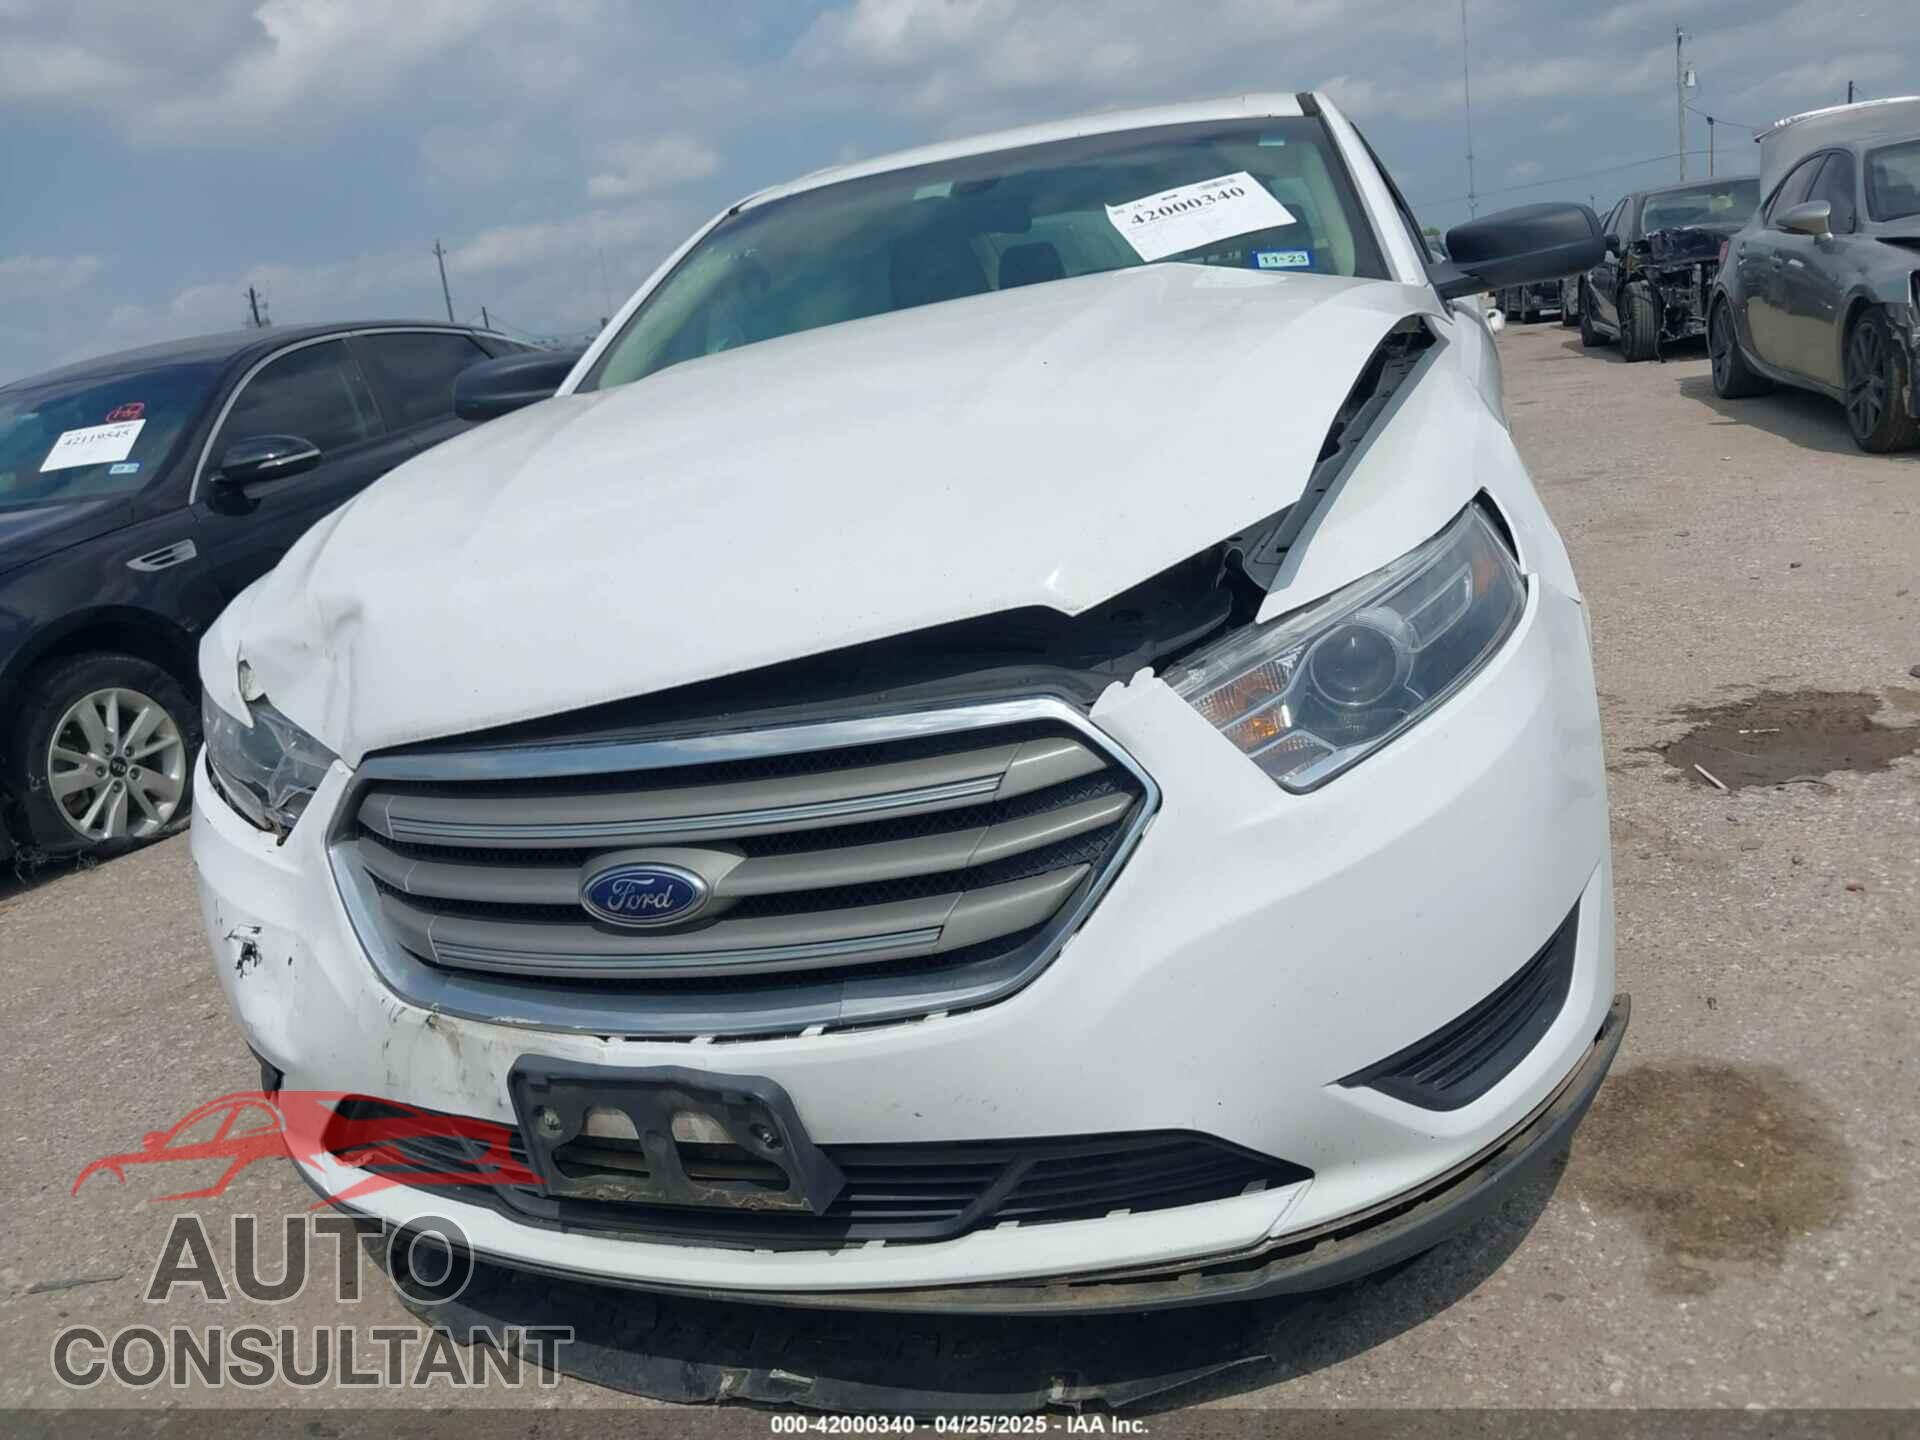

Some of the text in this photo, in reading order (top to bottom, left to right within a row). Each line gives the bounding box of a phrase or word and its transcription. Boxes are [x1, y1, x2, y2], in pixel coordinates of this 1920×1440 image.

[1131, 186, 1245, 226] 42000340
[1261, 254, 1307, 264] 11-23
[607, 878, 673, 911] Ford
